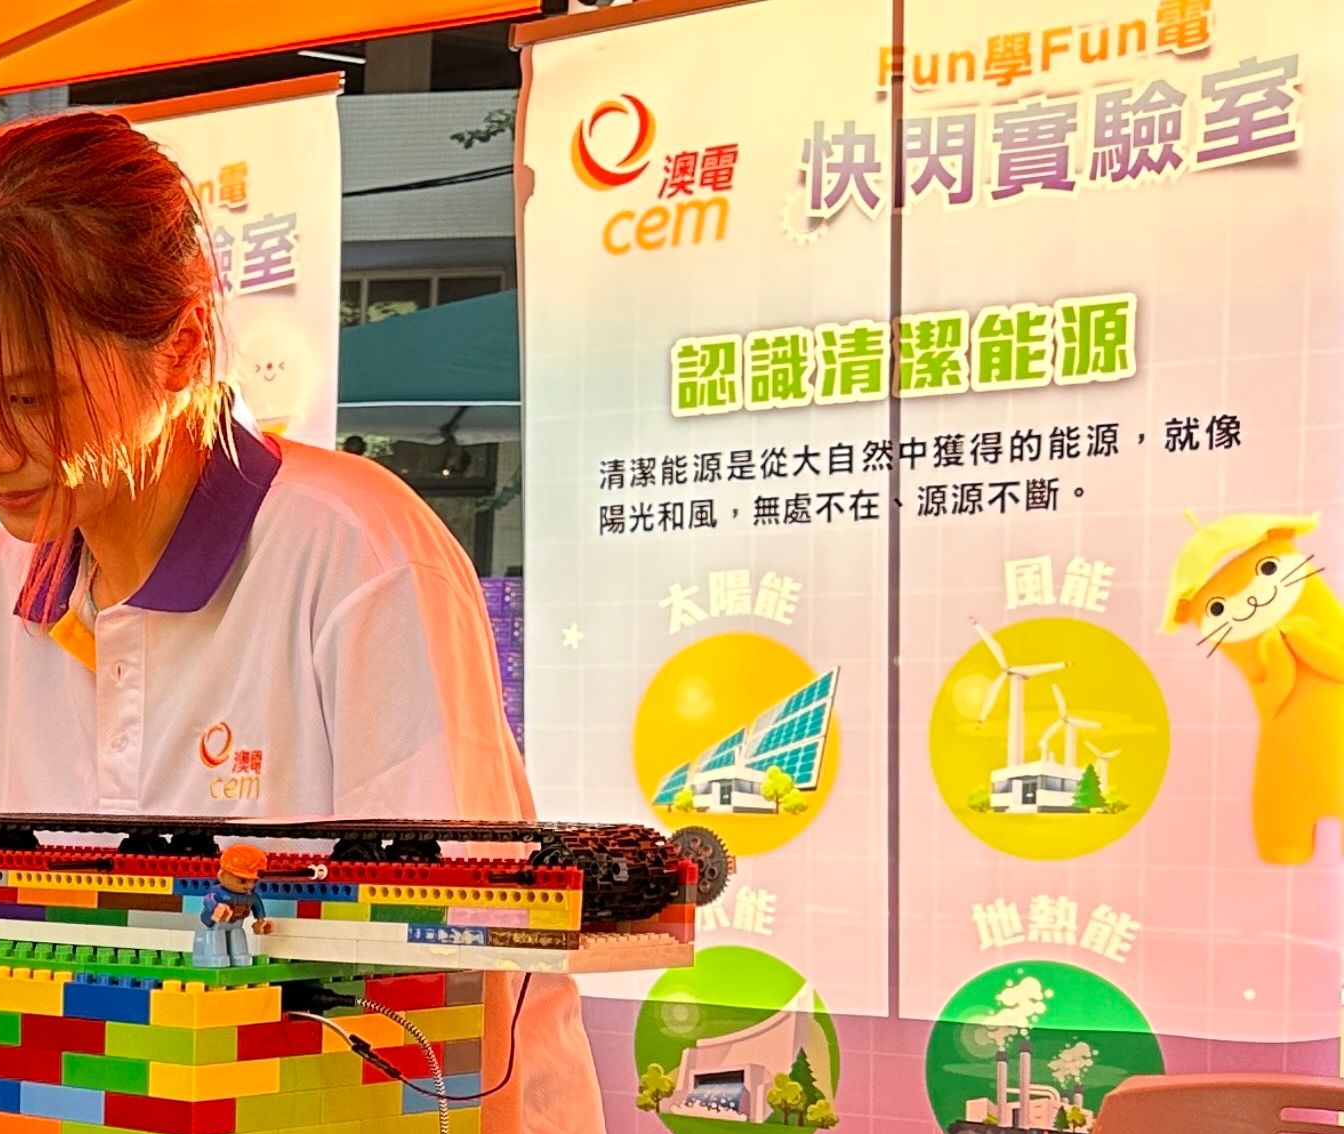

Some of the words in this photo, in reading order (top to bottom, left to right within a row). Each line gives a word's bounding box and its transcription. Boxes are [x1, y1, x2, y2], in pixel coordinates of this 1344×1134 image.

[876, 0, 1215, 90] Fun學Fun電
[800, 55, 1301, 212] 快閃實驗室
[659, 143, 739, 199] 澳電
[602, 195, 729, 256] cem
[674, 298, 1136, 412] 認識清潔能源
[659, 569, 802, 634] 太陽能
[1004, 555, 1115, 613] 風能
[210, 775, 261, 801] cem
[972, 893, 1142, 964] 地熱能
